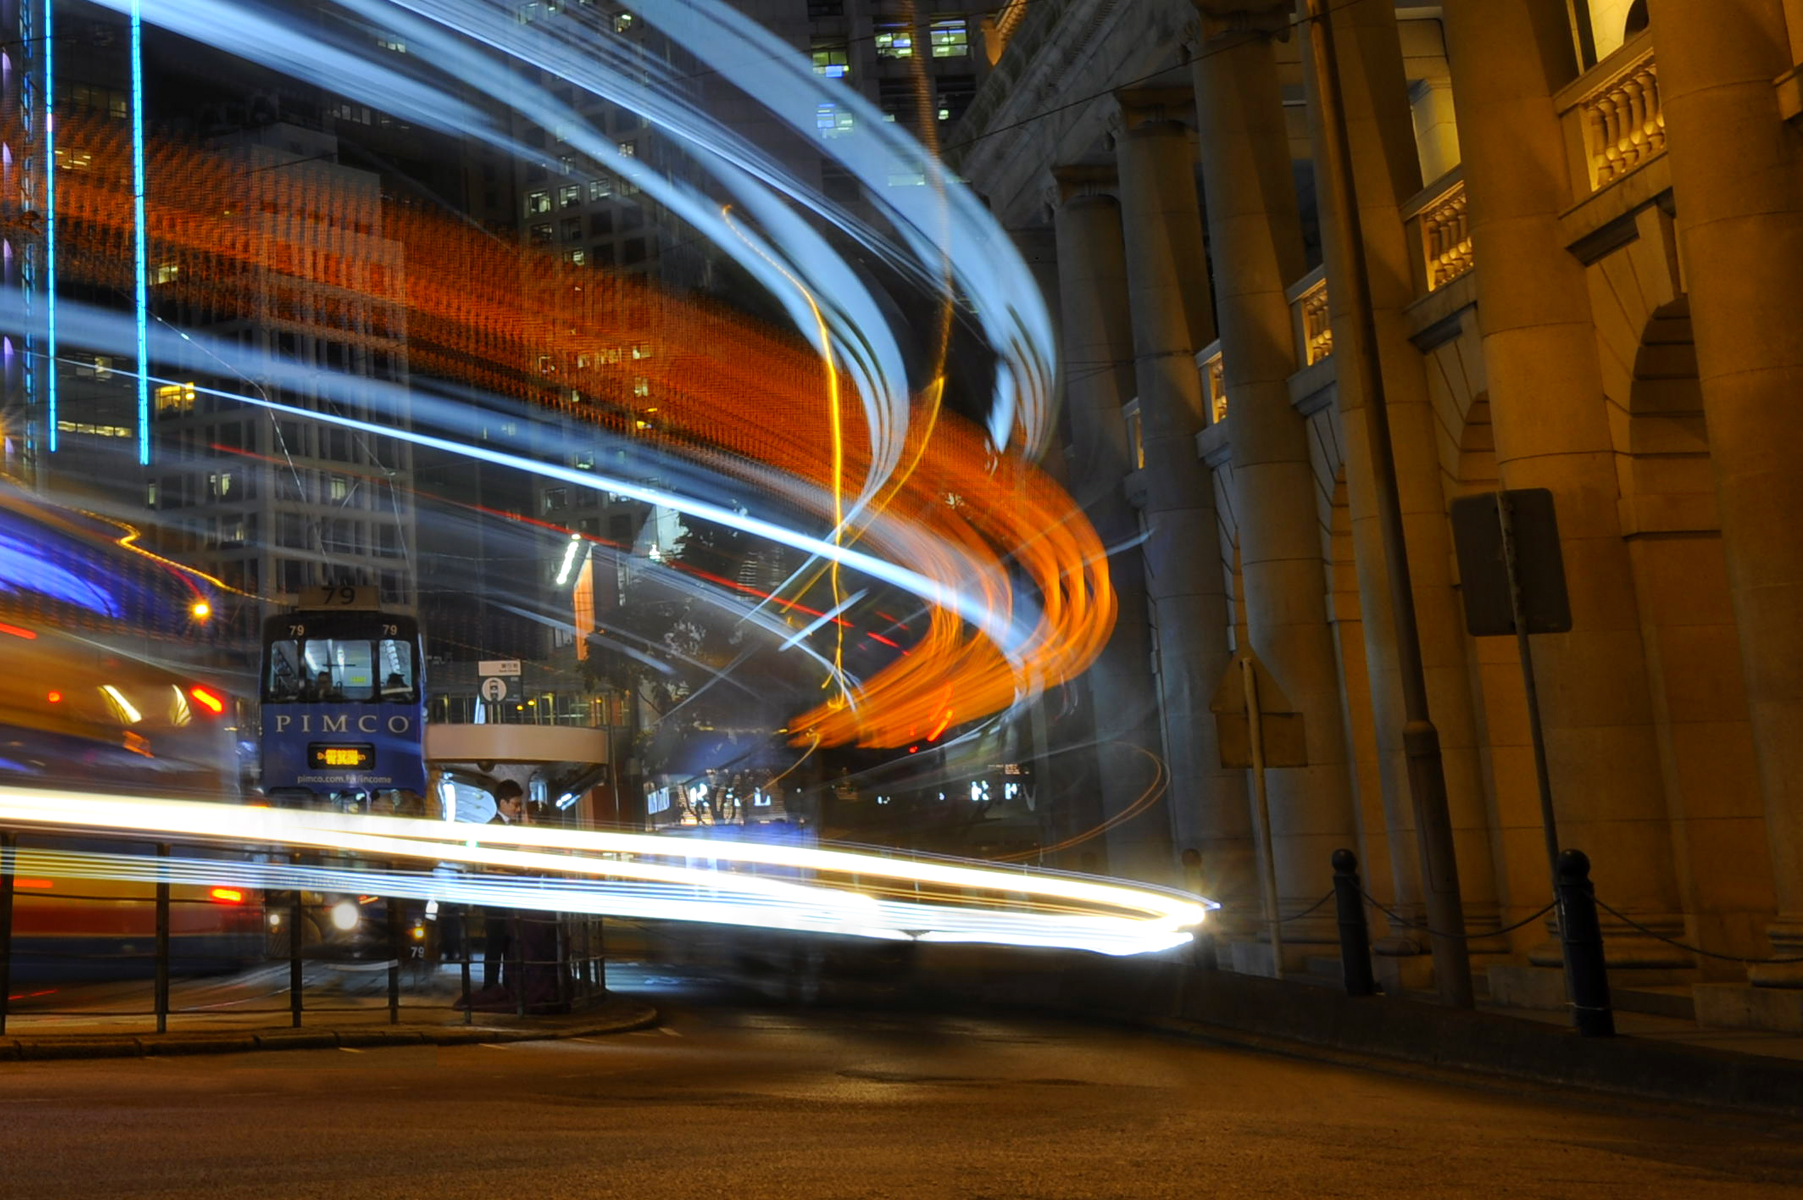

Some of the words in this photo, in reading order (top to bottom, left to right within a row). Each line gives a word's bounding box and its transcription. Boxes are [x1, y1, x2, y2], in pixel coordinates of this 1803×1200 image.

[321, 586, 356, 605] 79
[289, 624, 305, 636] 79
[382, 624, 398, 636] 79
[275, 714, 409, 733] PIMCO
[410, 946, 425, 958] 79
